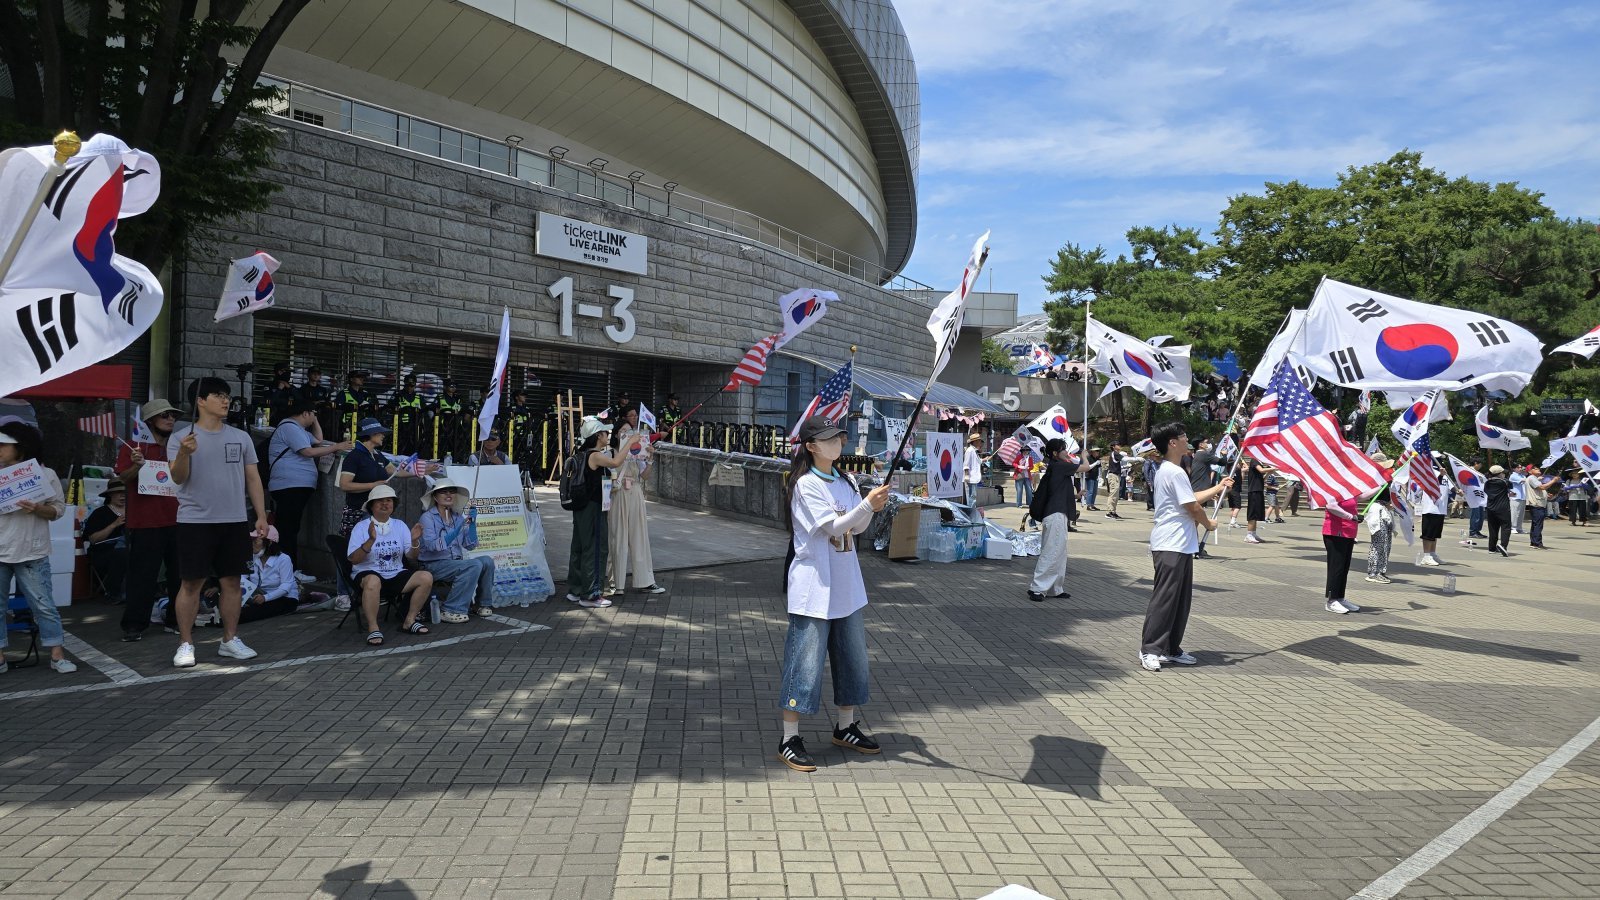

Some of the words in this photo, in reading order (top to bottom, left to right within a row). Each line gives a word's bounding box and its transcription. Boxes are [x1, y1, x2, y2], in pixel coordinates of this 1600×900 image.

[563, 223, 627, 248] ticketLINK
[569, 237, 590, 250] LIVE
[591, 243, 621, 256] ARENA
[547, 276, 636, 344] 1-3
